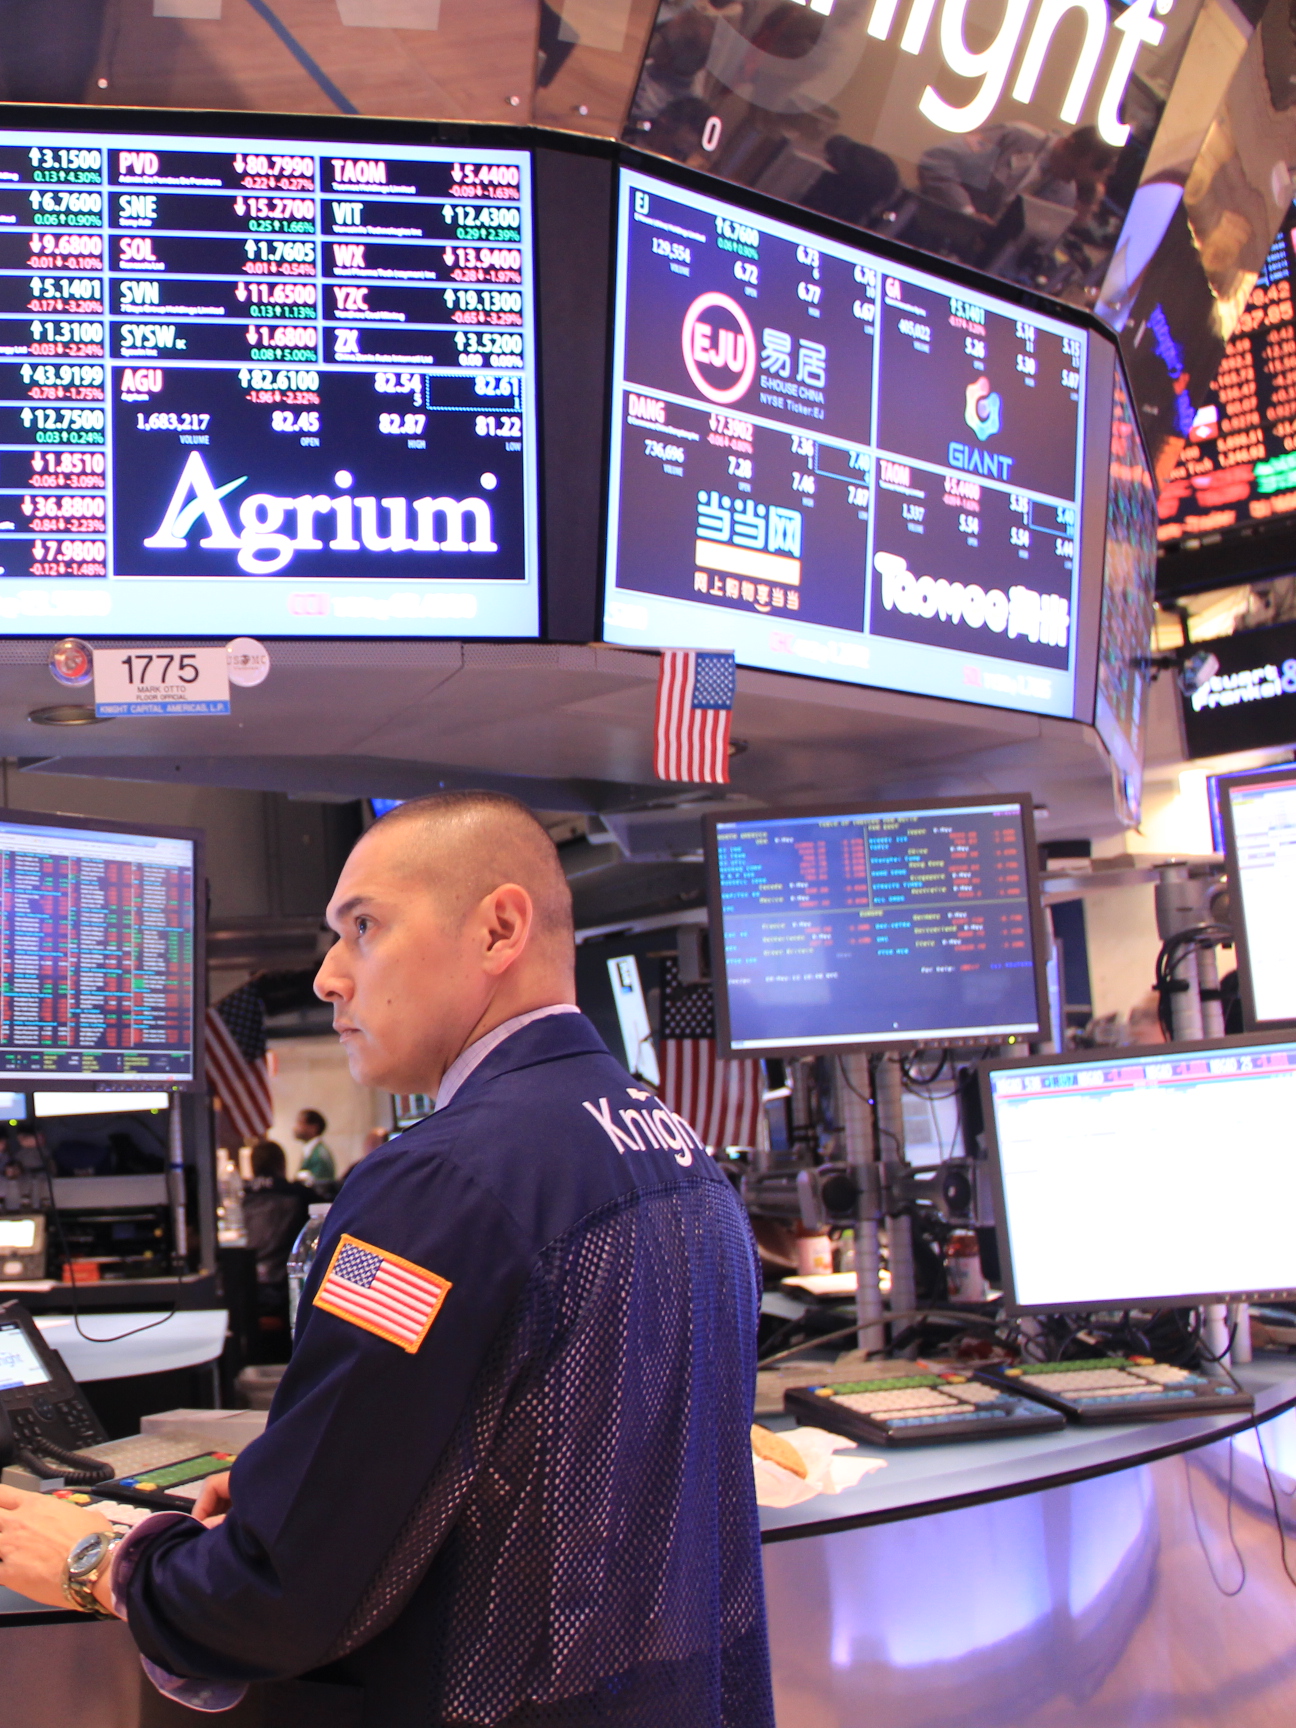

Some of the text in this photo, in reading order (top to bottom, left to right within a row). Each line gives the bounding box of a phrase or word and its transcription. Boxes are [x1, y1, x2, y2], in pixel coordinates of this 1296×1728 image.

[42, 149, 101, 169] 3.1500
[118, 152, 314, 176] PVD 80.7990
[331, 160, 520, 185] TAOM 5.4400
[42, 191, 101, 212] 6.7600
[118, 195, 314, 219] SNE 15.2700
[332, 202, 520, 228] VIT 12.4300
[42, 235, 102, 255] 9.6800
[119, 238, 315, 262] SOL 1.7605
[333, 244, 522, 269] WX 13.9400
[44, 278, 101, 299] 5.1401
[119, 281, 316, 304] SVN 11.6500
[333, 287, 522, 311] YZC 19.1300
[45, 321, 103, 342] 1.3100
[120, 324, 317, 348] SYSW 1.6800
[333, 330, 523, 354] ZX 3.5200
[693, 322, 746, 373] EJU
[760, 327, 826, 388] 易居
[33, 364, 104, 385] 43.9199
[121, 369, 319, 392] AGU 82.6100
[760, 375, 824, 404] E-HOUSE CHINA
[35, 409, 104, 429] 12.7500
[136, 411, 522, 437] 1,683,217 82.45 82.87 81.22
[44, 453, 104, 474] 1.8510
[948, 441, 1014, 481] GIANT
[35, 496, 104, 517] 36.8800
[144, 451, 498, 574] Agrium
[696, 490, 802, 558] 当当网
[44, 541, 105, 561] 7.9800
[122, 655, 199, 684] 1775
[164, 685, 186, 693] OTTO
[100, 705, 128, 714] KNIGHT
[130, 704, 163, 713] CAPITAL
[582, 1096, 714, 1167] Knigh
